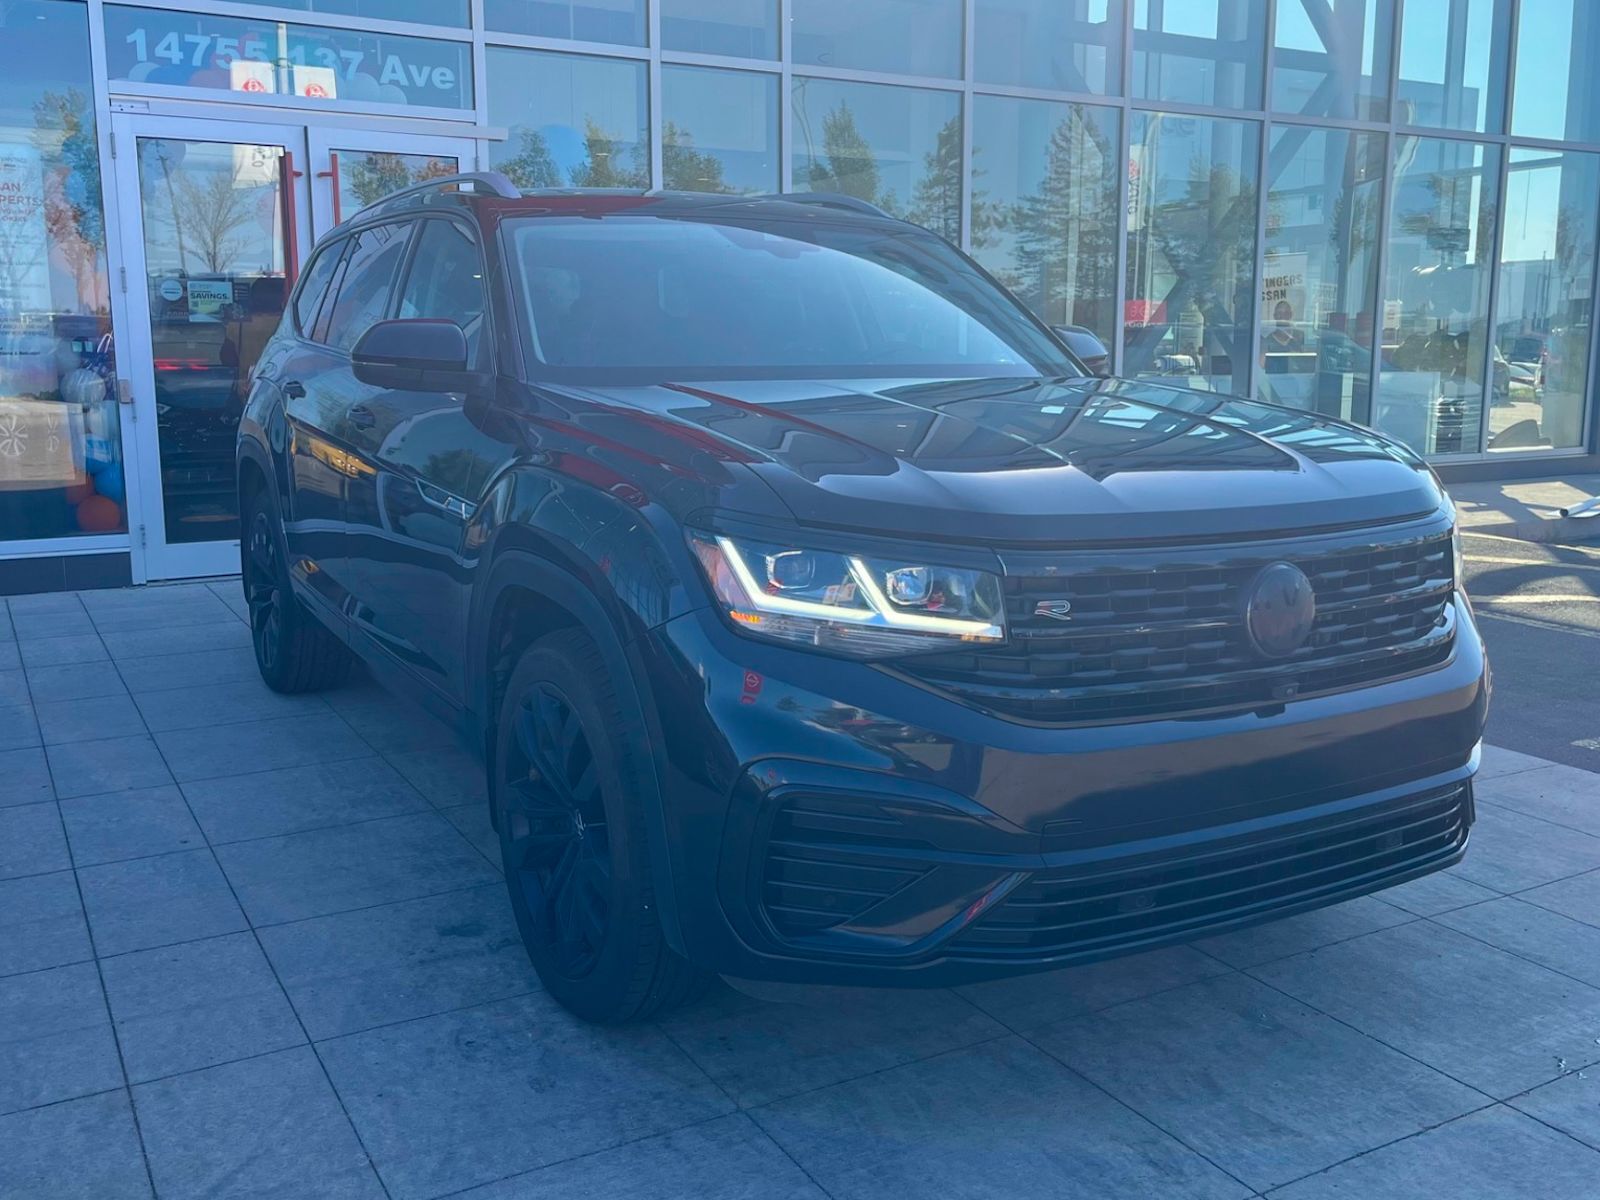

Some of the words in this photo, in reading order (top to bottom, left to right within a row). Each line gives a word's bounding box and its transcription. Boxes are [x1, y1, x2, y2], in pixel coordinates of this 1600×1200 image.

[380, 55, 455, 90] Ave
[1262, 273, 1304, 288] INGERS
[1034, 600, 1071, 620] R
